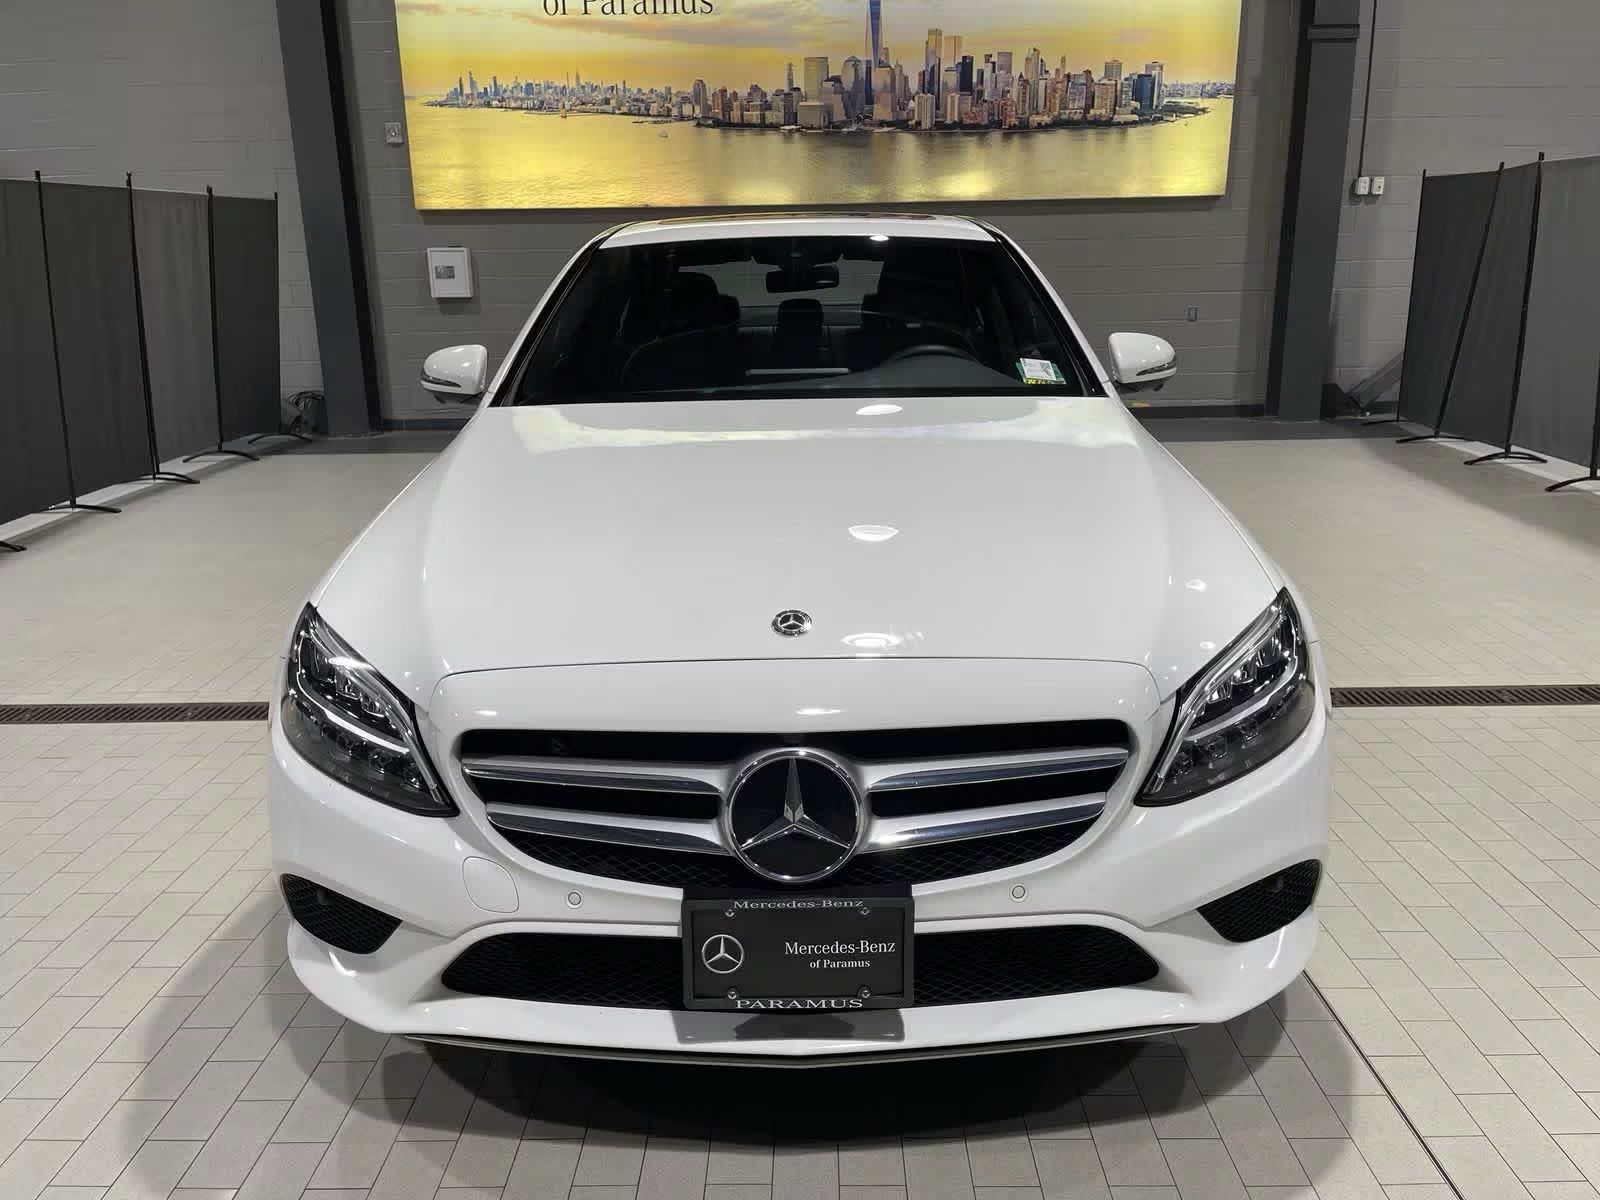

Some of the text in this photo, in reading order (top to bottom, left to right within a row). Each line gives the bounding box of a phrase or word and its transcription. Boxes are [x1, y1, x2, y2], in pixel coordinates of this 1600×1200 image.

[581, 0, 713, 16] Paramus
[733, 900, 864, 909] Mercedes-Benz
[784, 940, 896, 954] Mercedes-Benz
[809, 959, 871, 968] of Paramus
[735, 999, 863, 1009] PARAMUS
